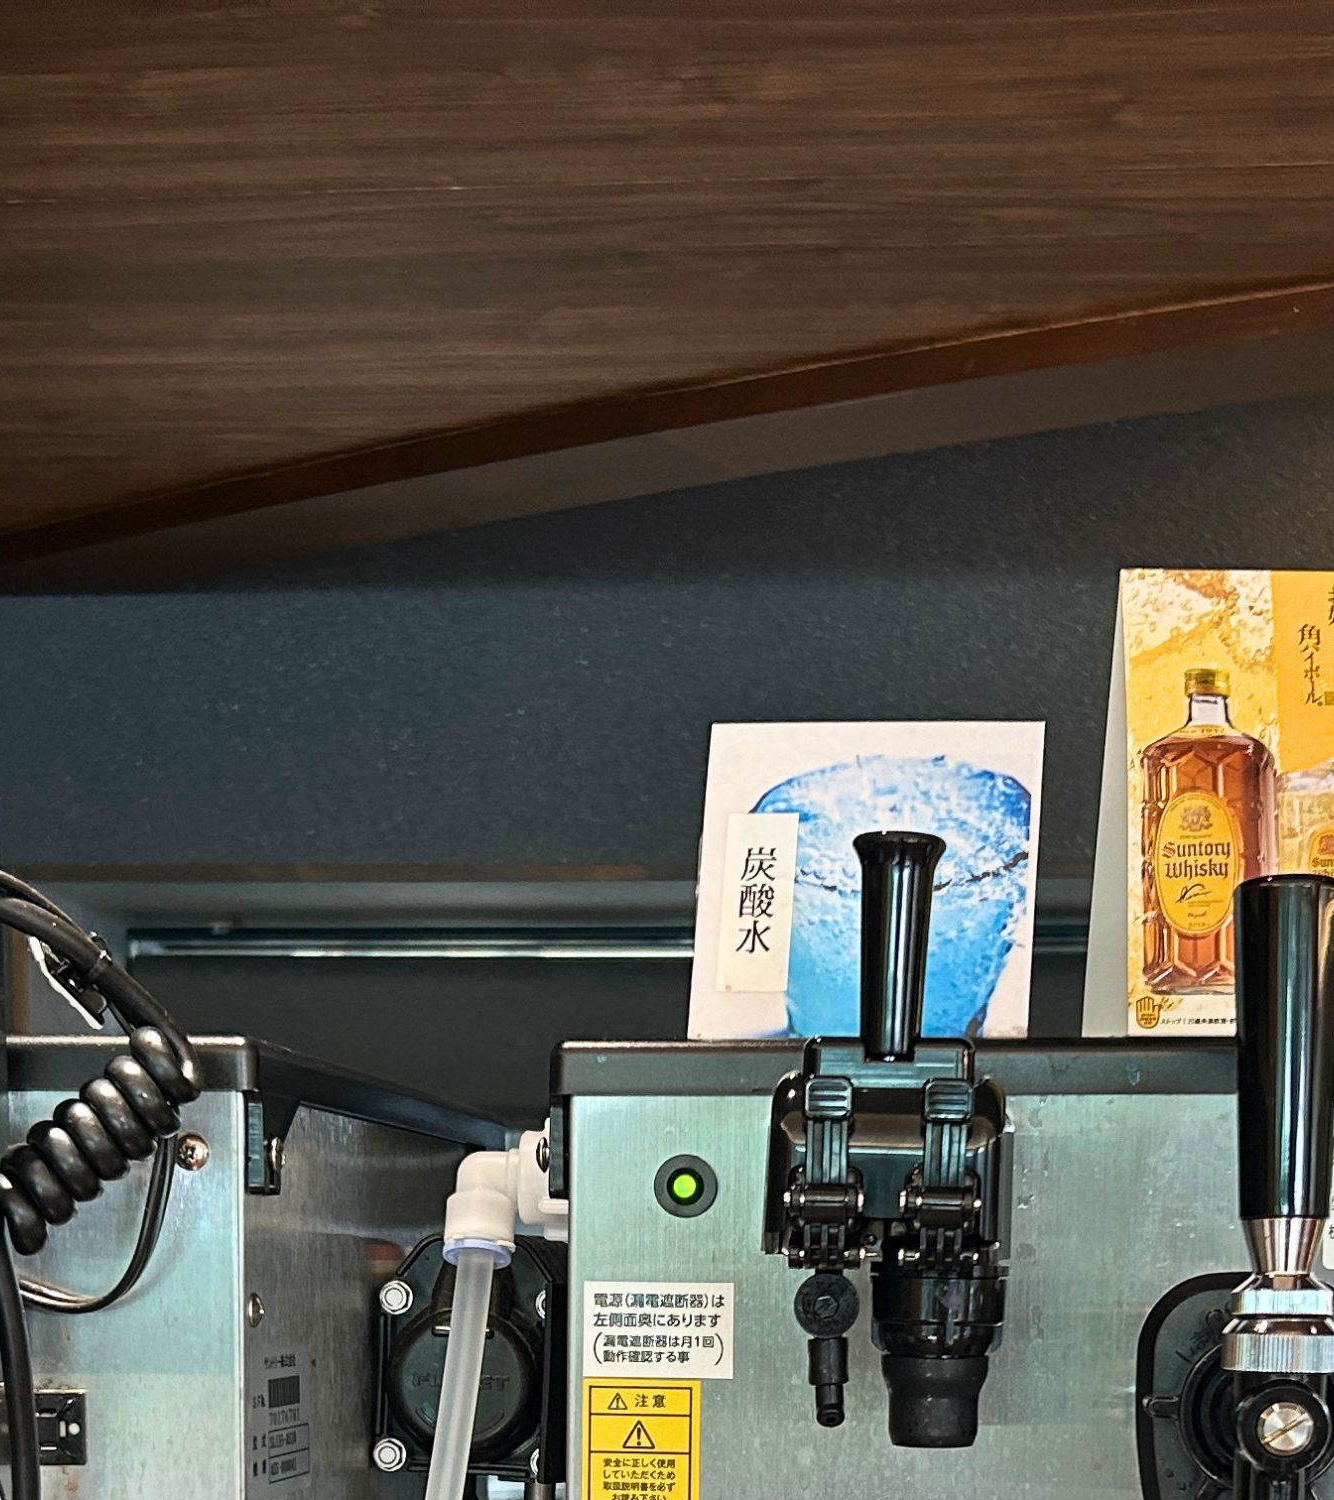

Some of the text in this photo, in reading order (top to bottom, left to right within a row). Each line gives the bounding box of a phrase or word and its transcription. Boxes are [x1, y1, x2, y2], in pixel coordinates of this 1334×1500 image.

[1162, 841, 1231, 859] Suntory
[1165, 859, 1228, 879] Whisky
[736, 847, 777, 953] 炭酸水
[593, 1293, 725, 1309] 電源(漏電遮断器)は
[593, 1312, 721, 1328] 左側面奥にあります
[635, 1394, 666, 1408] 注意
[603, 1458, 675, 1468] 安全に正しく使用
[603, 1470, 675, 1480] していただくため
